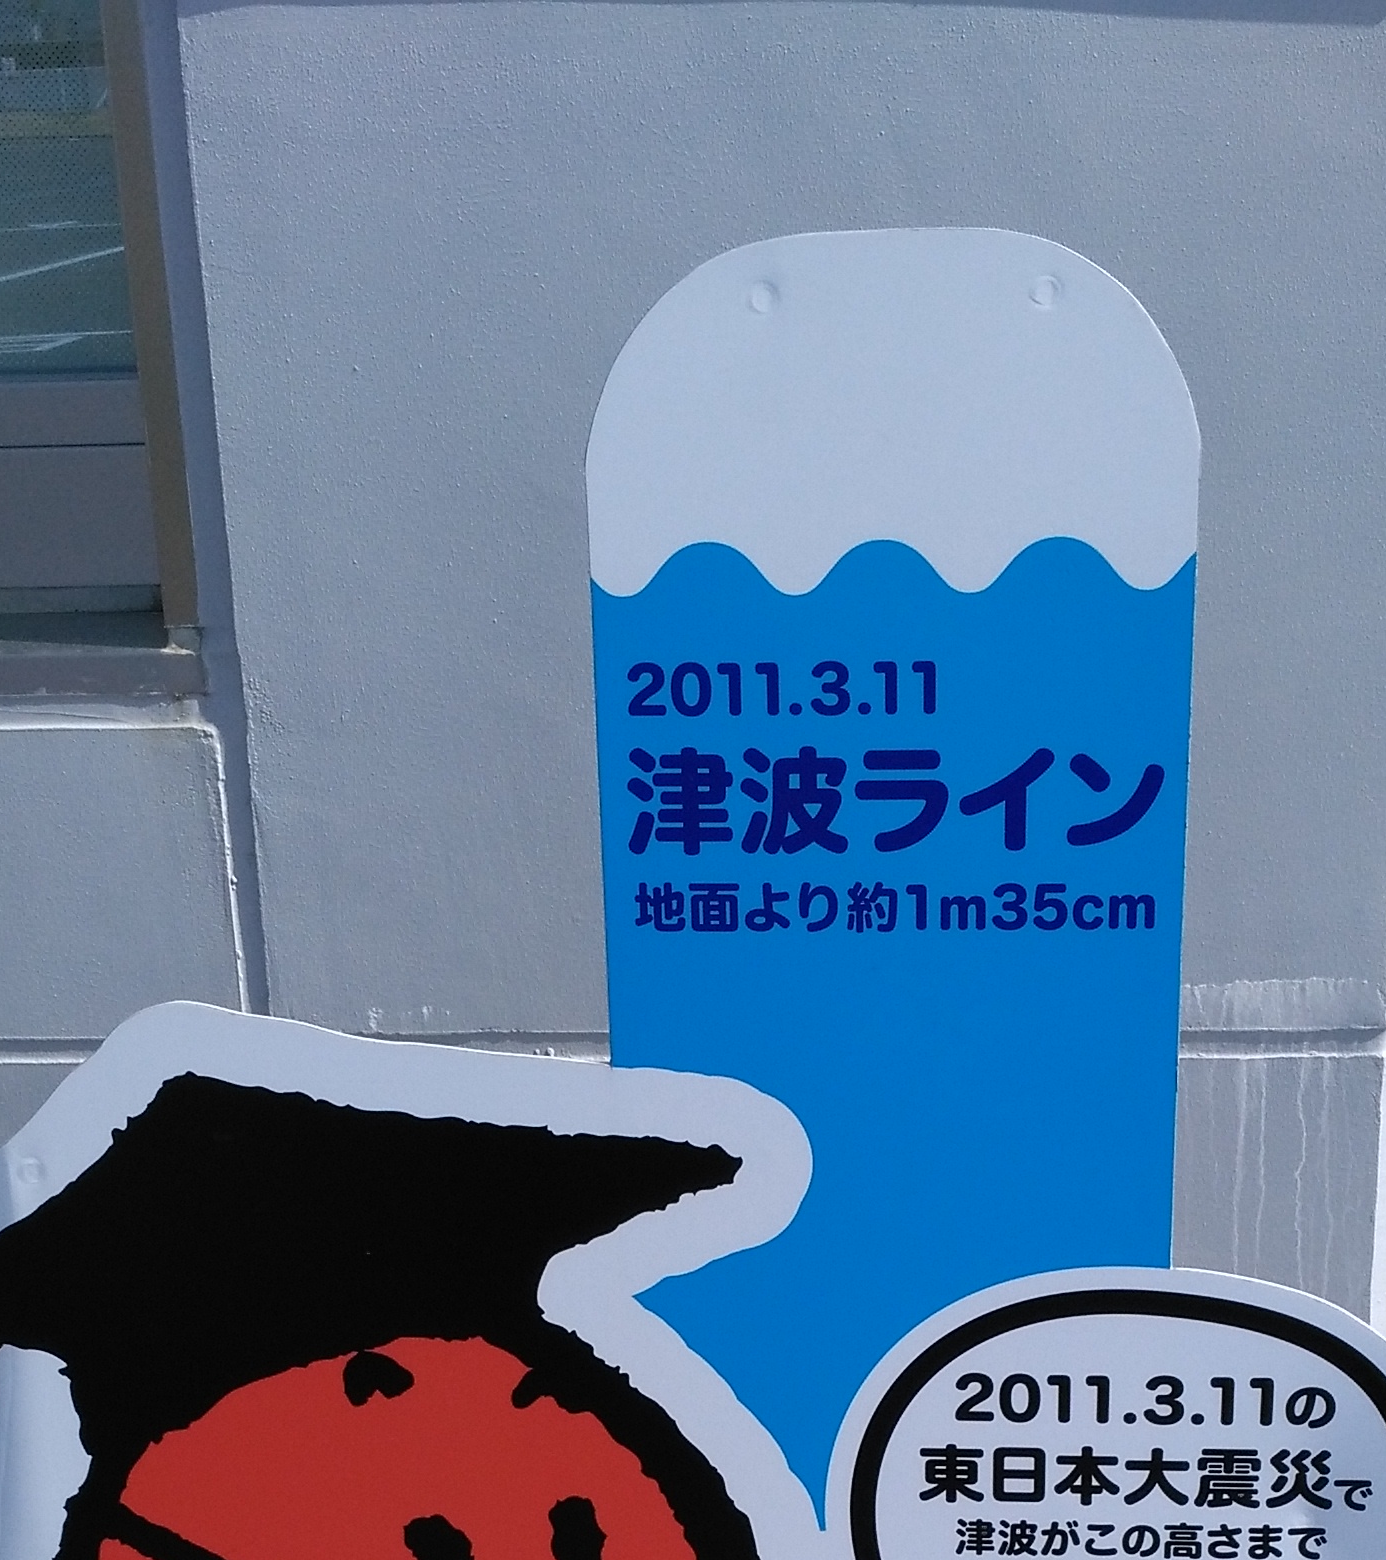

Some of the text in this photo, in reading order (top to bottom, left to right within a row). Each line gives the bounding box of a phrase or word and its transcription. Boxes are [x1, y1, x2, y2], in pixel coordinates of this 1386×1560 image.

[627, 660, 938, 718] 2011.3.11
[626, 745, 1166, 856] 津波ライン
[634, 881, 1157, 934] 地面より約1m35cm
[954, 1372, 1337, 1429] 2011.3.11の
[918, 1443, 1374, 1512] 東日本大震災で
[954, 1518, 1329, 1560] 津波がこの高さまで
